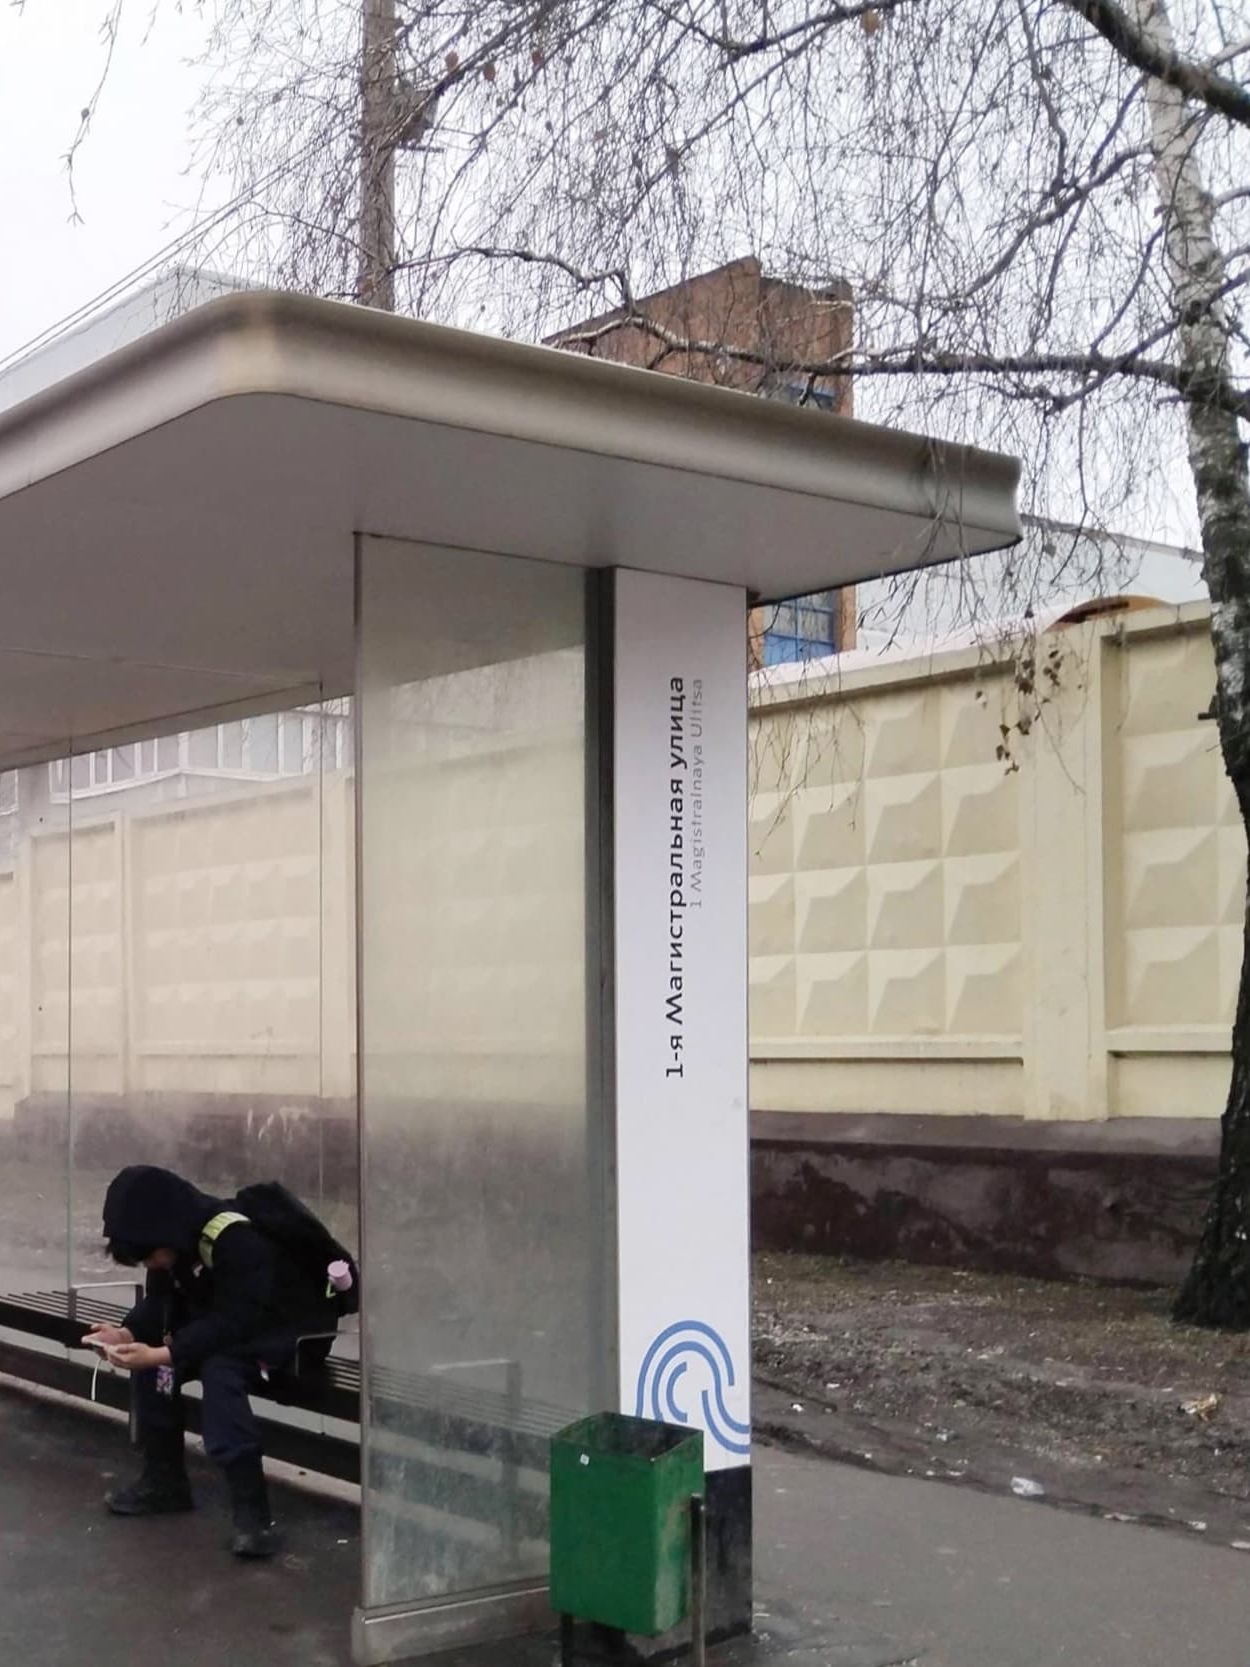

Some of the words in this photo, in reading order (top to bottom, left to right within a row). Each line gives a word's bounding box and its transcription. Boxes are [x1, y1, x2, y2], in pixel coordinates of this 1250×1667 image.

[670, 676, 688, 770] улица
[690, 678, 703, 739] Ulitsa
[690, 744, 706, 893] Magistralnaya
[665, 778, 687, 1025] Магистральная
[666, 1034, 684, 1078] 1-я
